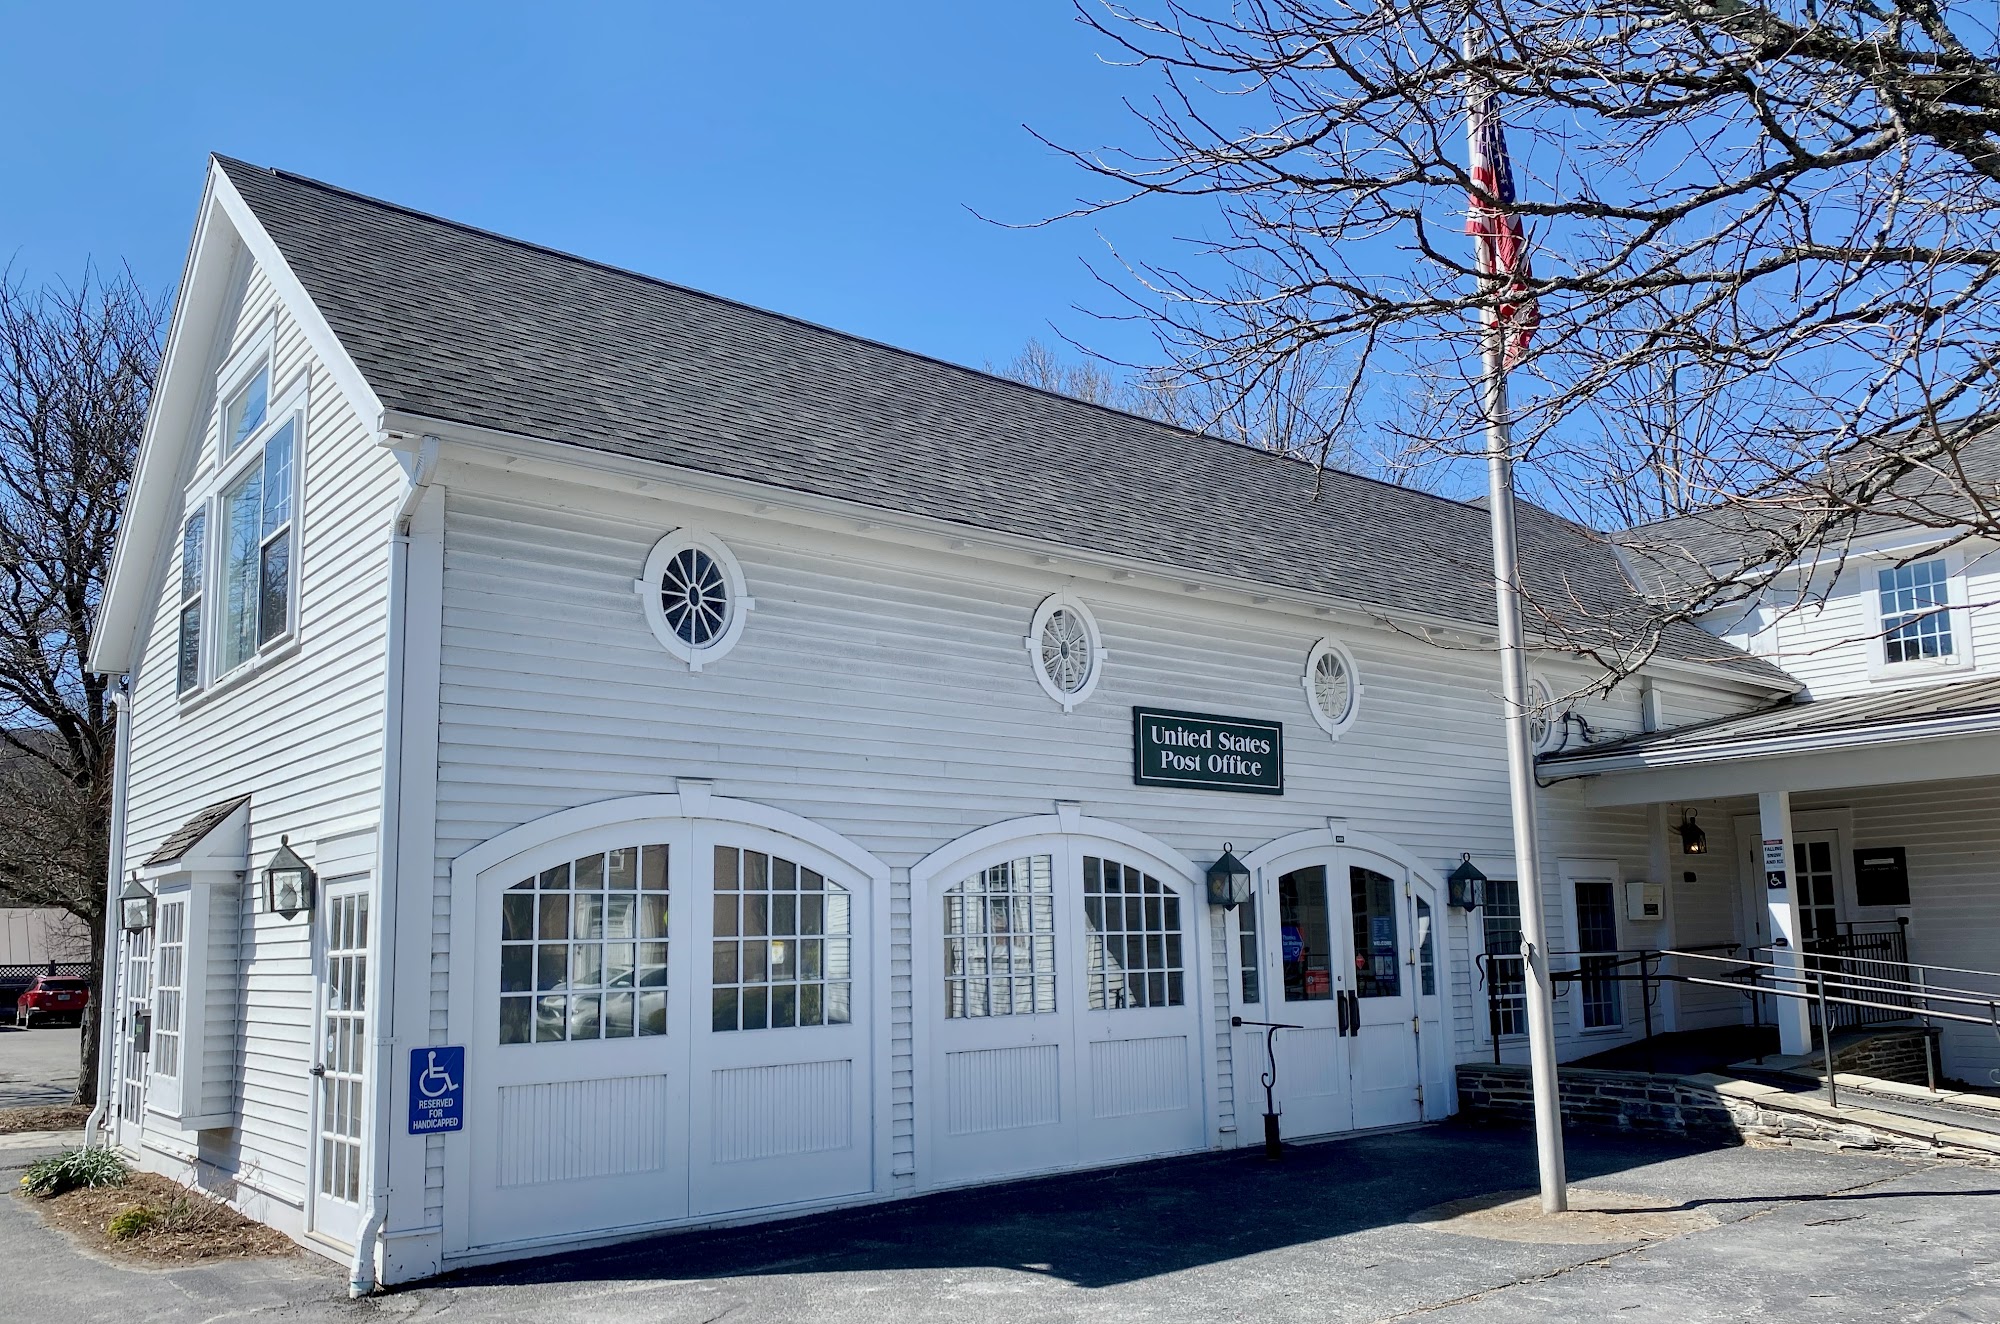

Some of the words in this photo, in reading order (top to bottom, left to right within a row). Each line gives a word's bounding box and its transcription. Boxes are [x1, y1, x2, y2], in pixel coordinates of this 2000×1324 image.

[1151, 725, 1212, 749] United
[1218, 732, 1270, 755] States
[1160, 750, 1201, 771] Post
[1207, 754, 1262, 777] Office
[419, 1098, 453, 1109] RESERVED
[428, 1109, 443, 1118] FOR
[413, 1118, 458, 1130] HANDICAPPED
